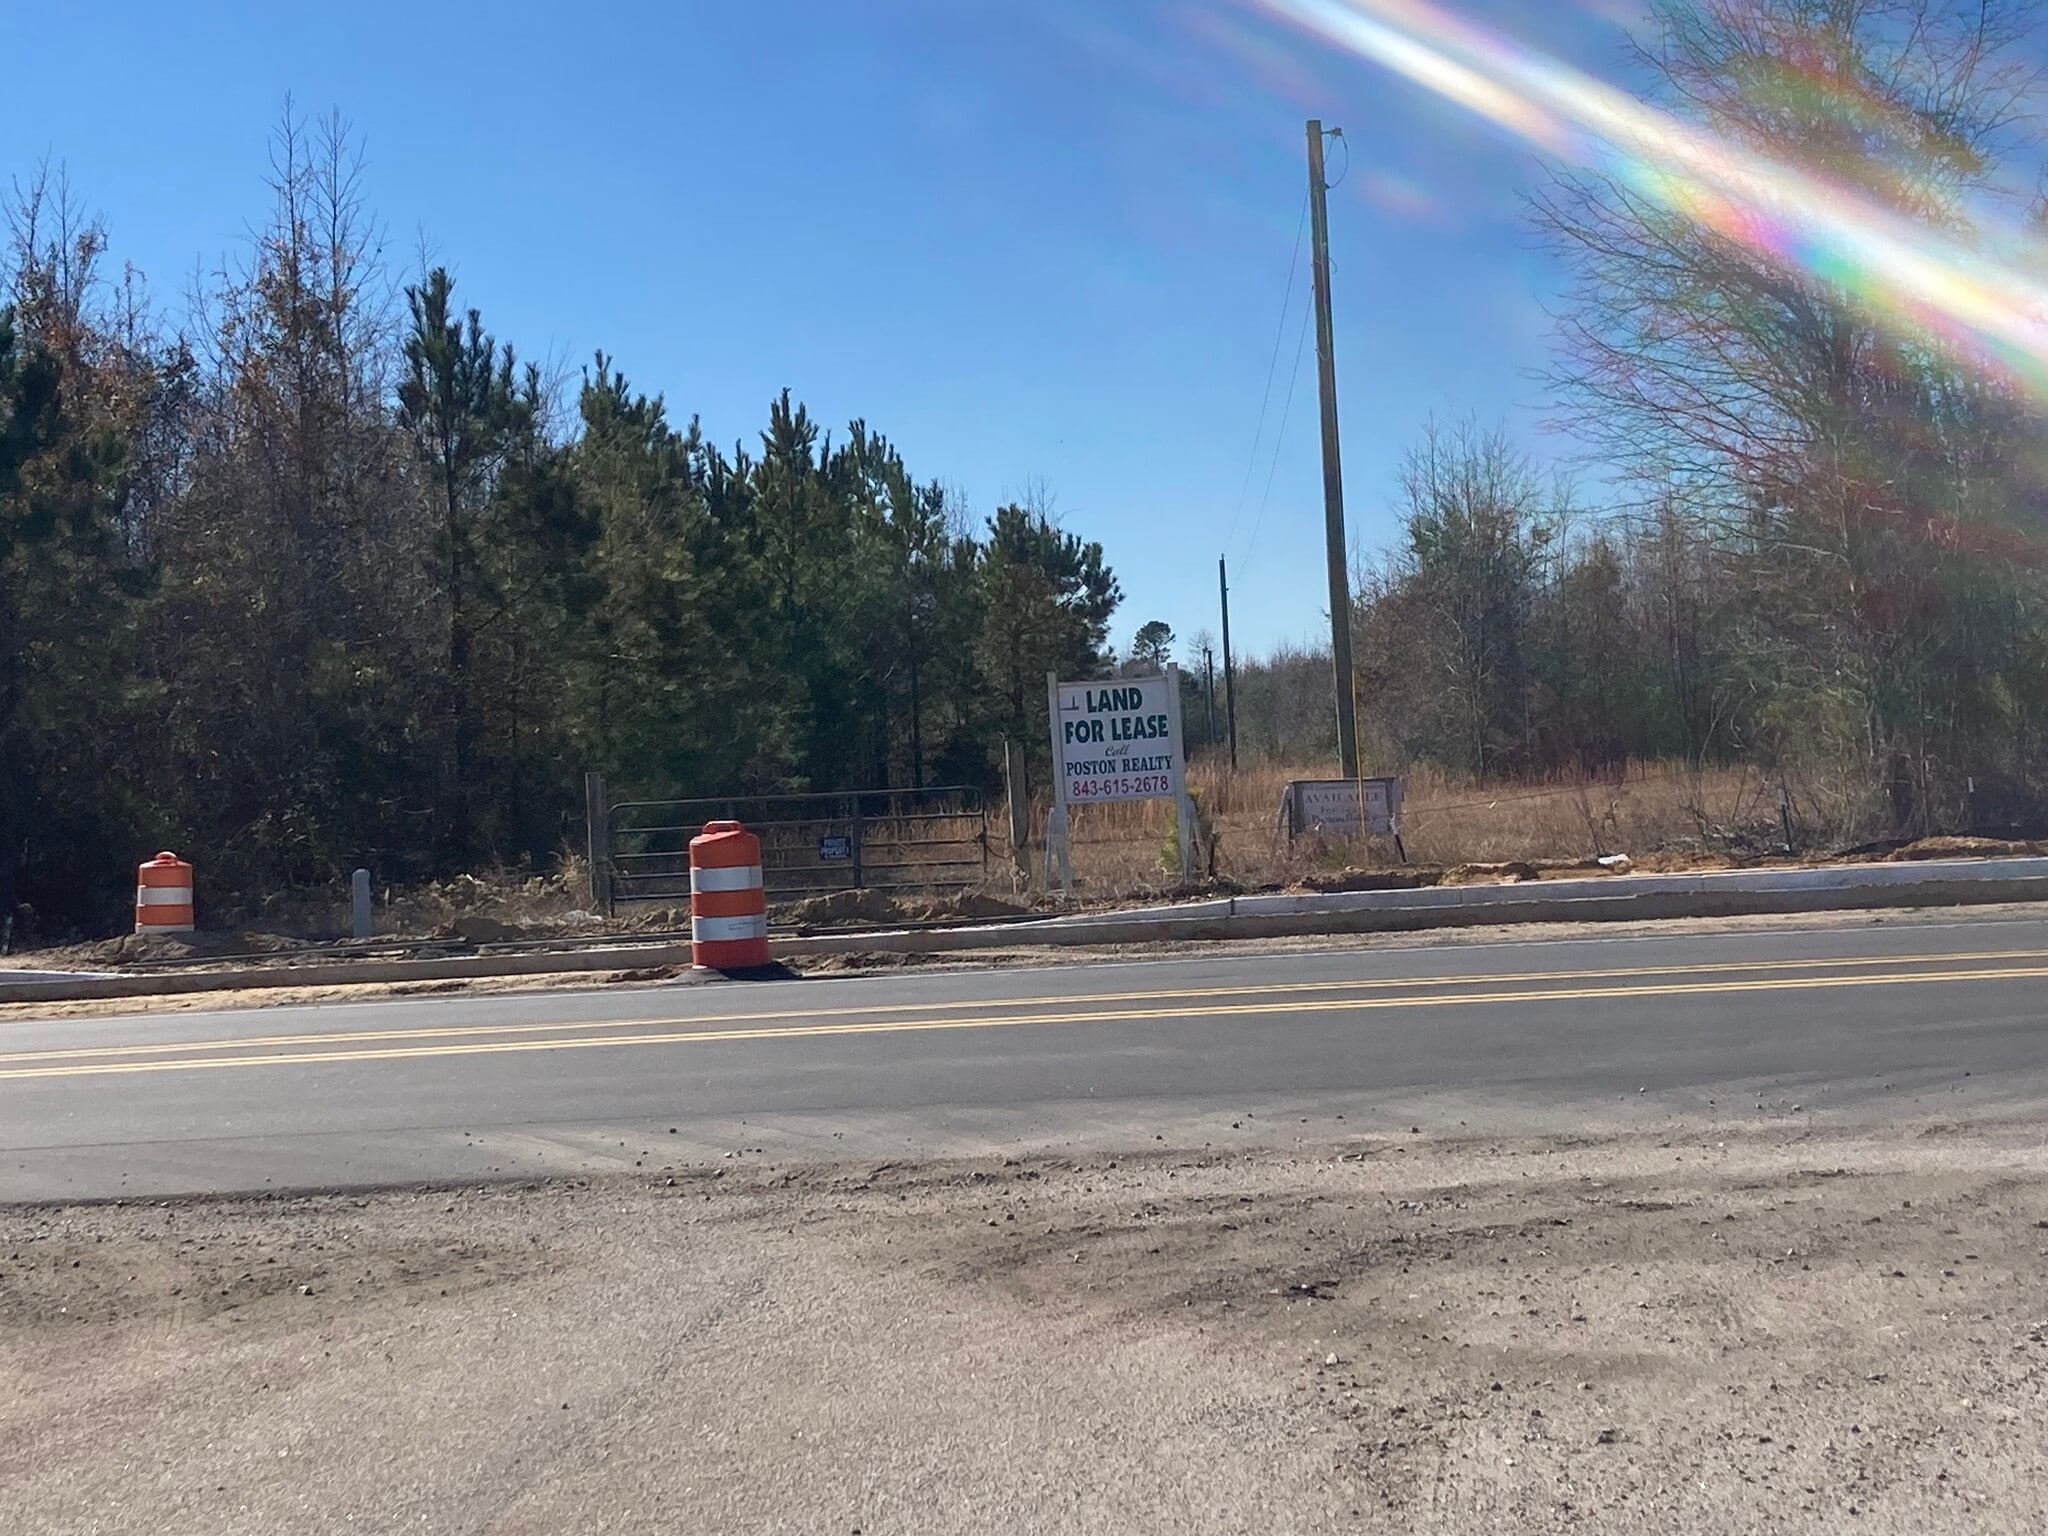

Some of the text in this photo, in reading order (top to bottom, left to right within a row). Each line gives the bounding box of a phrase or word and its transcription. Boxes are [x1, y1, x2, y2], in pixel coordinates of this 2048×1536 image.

[1086, 687, 1143, 713] LAND
[1064, 714, 1169, 744] FOR LEASE
[1104, 744, 1130, 757] Call
[1066, 755, 1172, 777] POSTON REALTY
[1072, 775, 1169, 797] 843-615-2678
